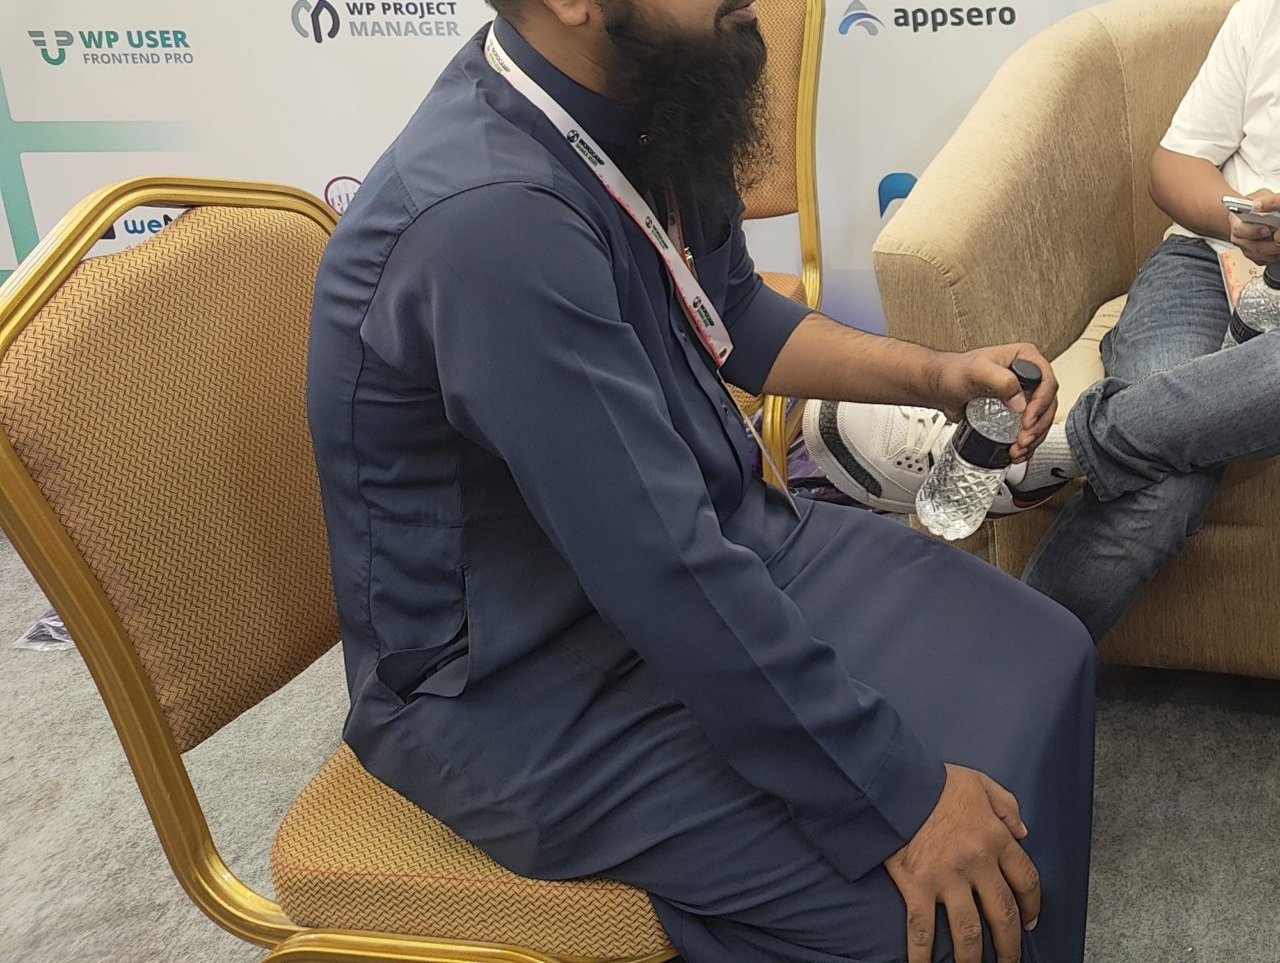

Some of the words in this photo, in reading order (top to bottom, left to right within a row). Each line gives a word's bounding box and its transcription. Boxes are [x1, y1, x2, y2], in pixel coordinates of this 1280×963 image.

[346, 1, 376, 16] WP
[381, 1, 458, 19] PROJECT
[893, 6, 1017, 33] appsero
[349, 21, 462, 37] MANAGER
[78, 29, 120, 49] WP
[126, 29, 191, 49] USER
[83, 52, 161, 65] FRONTEND
[164, 51, 194, 65] PRO
